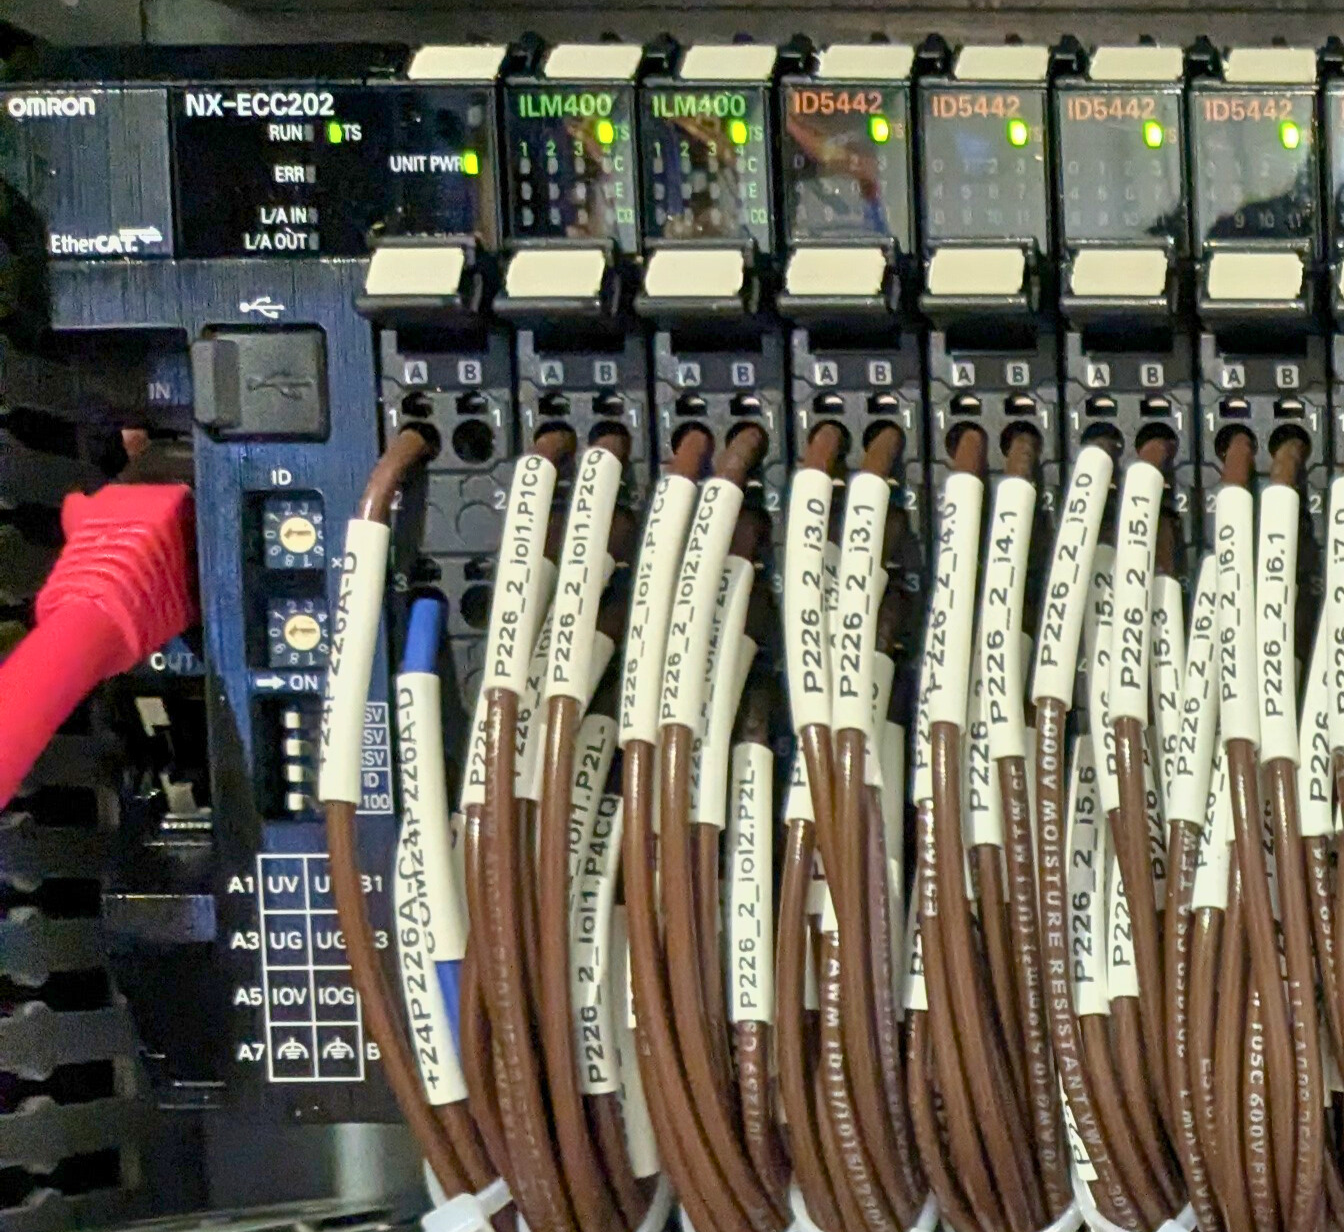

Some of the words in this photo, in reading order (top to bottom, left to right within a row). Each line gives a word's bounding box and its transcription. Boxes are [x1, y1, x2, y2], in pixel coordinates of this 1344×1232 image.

[185, 93, 335, 118] NX-ECC202
[519, 93, 613, 118] ILM400
[652, 93, 747, 118] ILM400
[793, 92, 883, 115] ID5442
[932, 93, 1020, 118] ID5442
[1067, 99, 1156, 121] ID5442
[1205, 99, 1293, 121] ID5442
[268, 124, 304, 141] RUN
[273, 165, 305, 182] ERR
[389, 155, 427, 173] UNIT
[260, 206, 288, 224] L/A
[290, 206, 308, 223] IN
[244, 232, 272, 250] L/A
[274, 232, 308, 250] OUT
[148, 382, 171, 400] IN
[270, 469, 292, 486] ID
[1040, 473, 1093, 667] P226_2_i5.0
[800, 499, 829, 694] P226_2_i3.0
[838, 503, 874, 698] P226_2_i3.1
[1120, 495, 1149, 689] P226_2_i5.1
[987, 510, 1017, 724] P226_2_i4.1
[1219, 525, 1240, 700] P226_2_i6.0
[1264, 533, 1288, 717] P226_2_i6.1
[289, 674, 320, 691] ON
[1177, 592, 1216, 777] P226_2_i6.2
[227, 875, 256, 894] A1
[267, 875, 299, 893] UV
[1043, 800, 1063, 948] MOISTURE
[1072, 765, 1098, 983] P226_2_i5.6
[230, 932, 260, 950] A3
[270, 932, 303, 950] UG
[233, 987, 264, 1006] A5
[272, 987, 307, 1005] IOV
[317, 987, 356, 1005] IOG
[1050, 958, 1082, 1103] RESISTANT
[237, 1042, 266, 1061] A7
